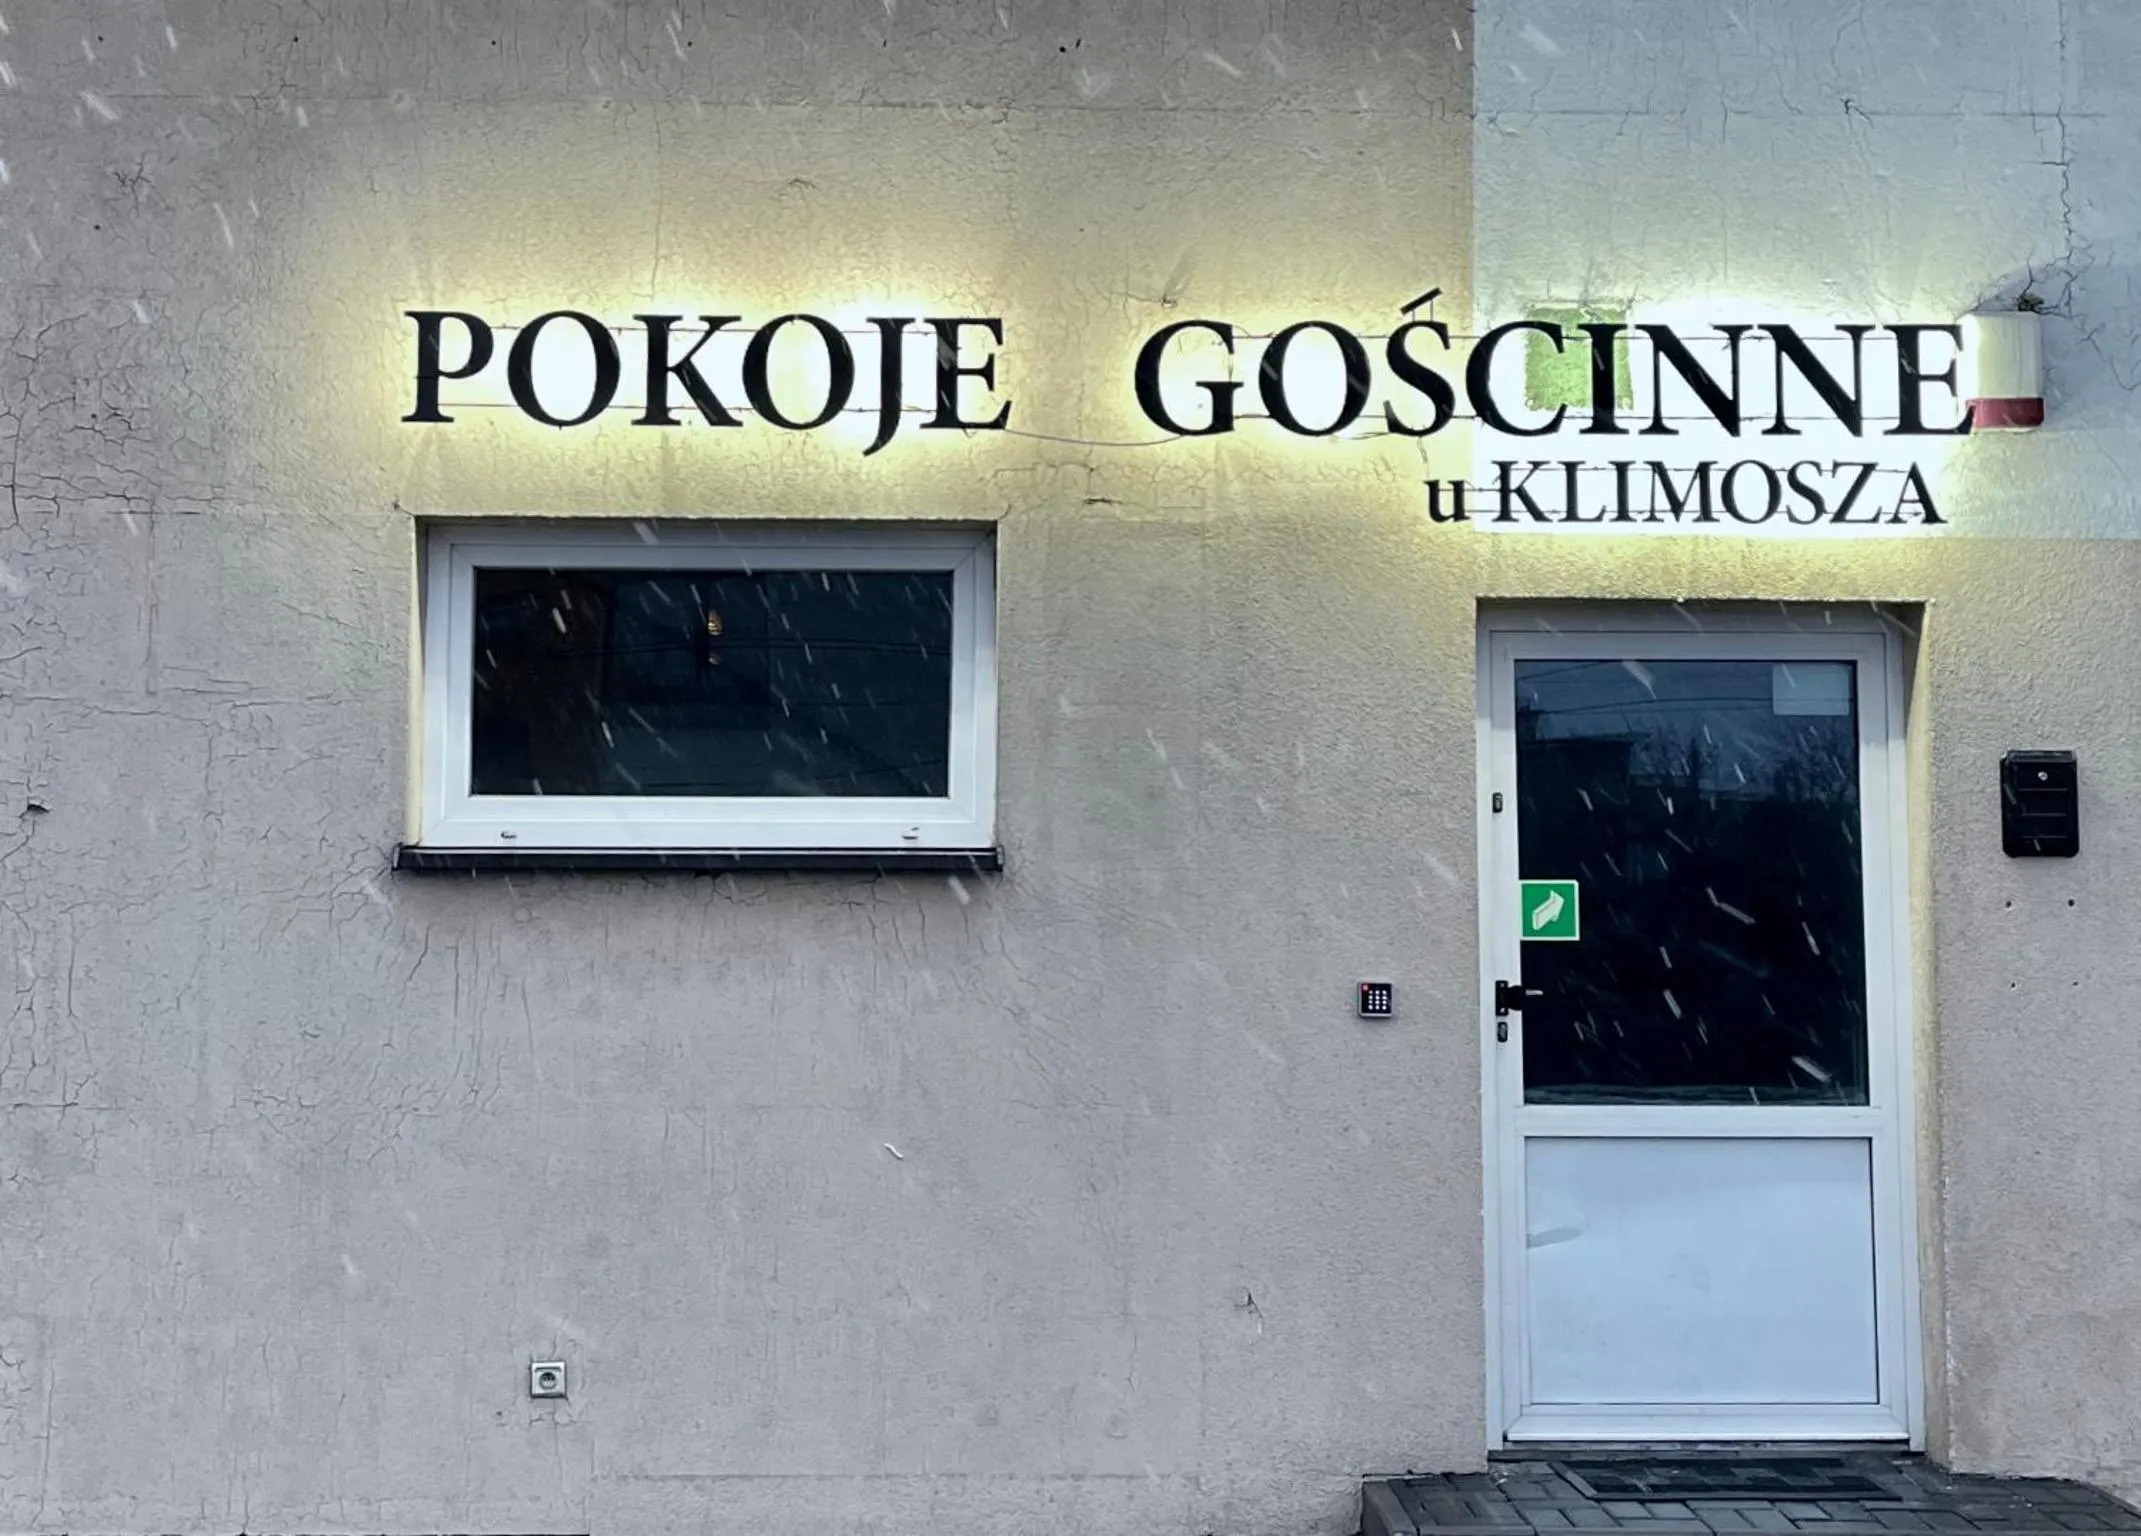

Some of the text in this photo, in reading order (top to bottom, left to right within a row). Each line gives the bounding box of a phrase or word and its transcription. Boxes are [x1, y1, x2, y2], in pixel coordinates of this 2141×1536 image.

[401, 288, 1975, 457] POKOJE GOŚCINNE
[1424, 459, 1948, 525] u KLIMOSZA
